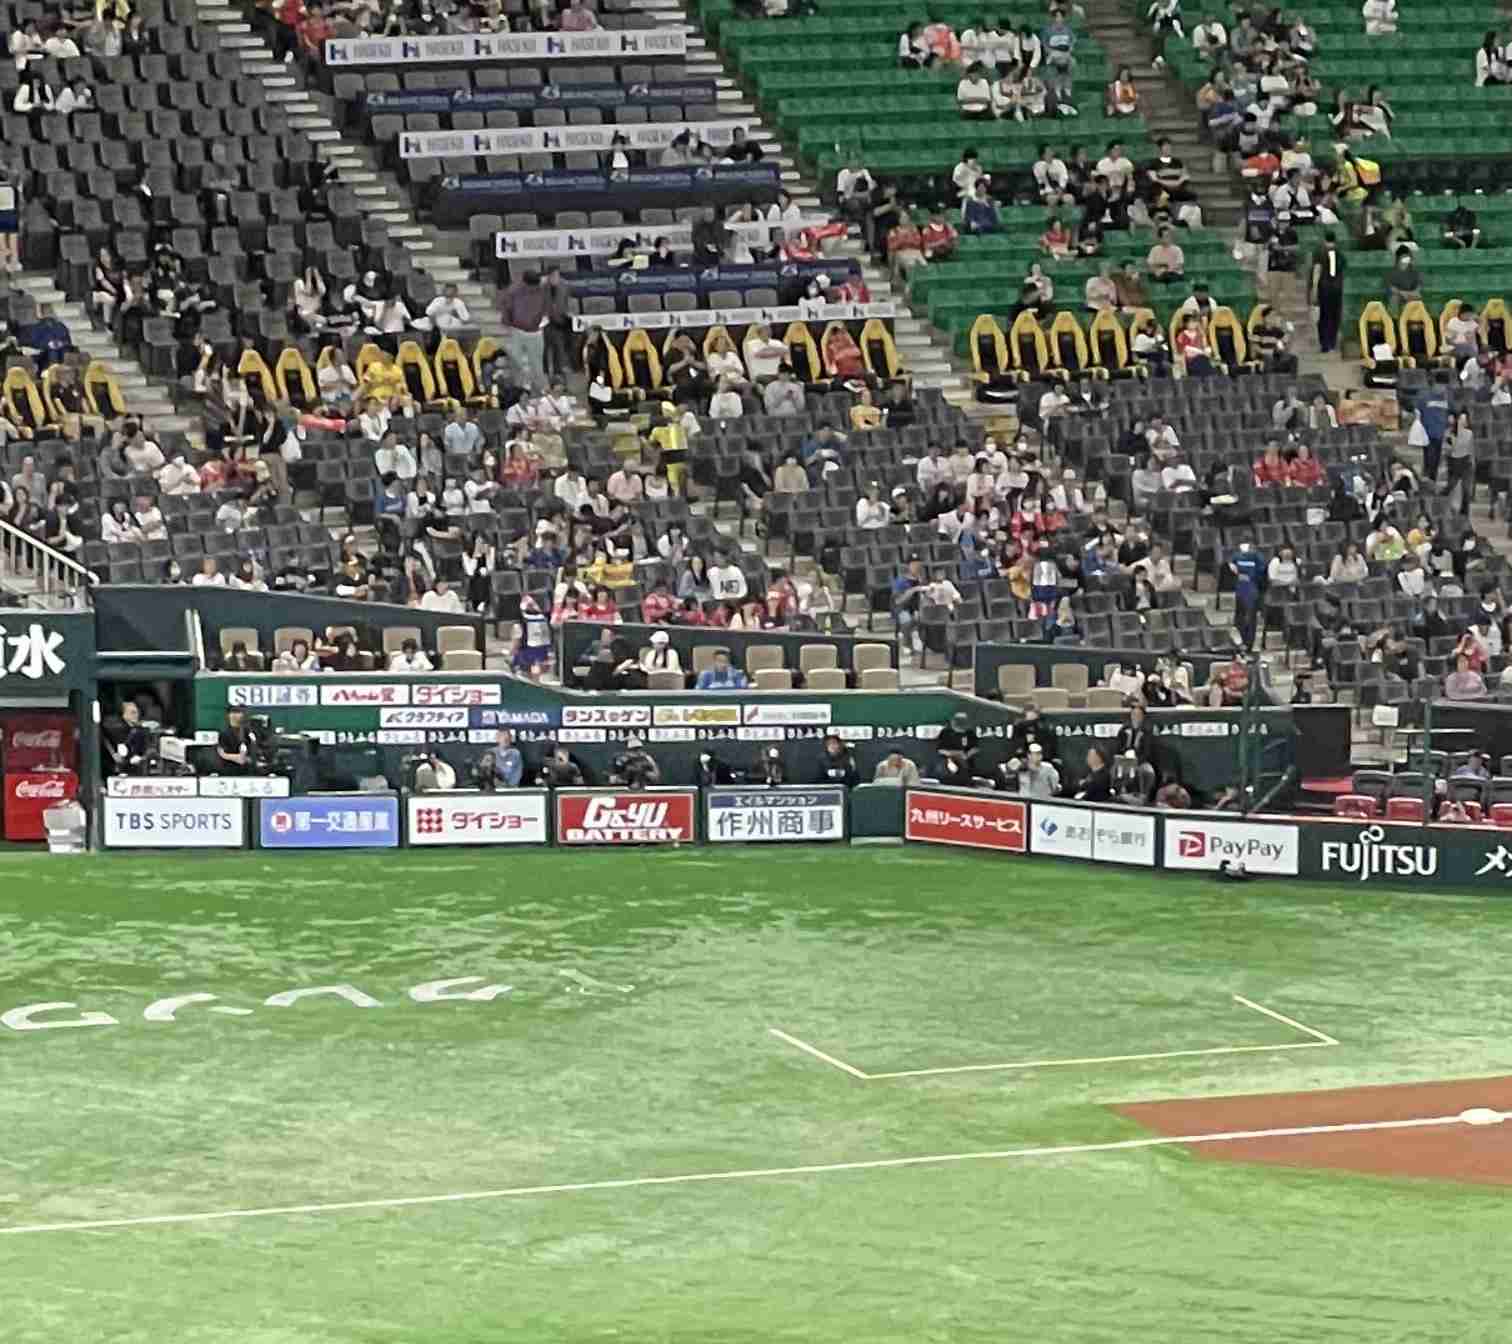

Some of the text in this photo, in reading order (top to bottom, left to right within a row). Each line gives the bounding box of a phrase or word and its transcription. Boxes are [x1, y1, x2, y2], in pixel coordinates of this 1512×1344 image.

[0, 624, 65, 679] 水
[417, 686, 499, 704] ダイショー
[115, 813, 232, 830] TBS SPORTS
[451, 812, 538, 830] ダイショー
[910, 807, 1023, 834] 九州リースサービス
[1210, 836, 1284, 861] PayPay
[1322, 826, 1438, 880] FUJITSU
